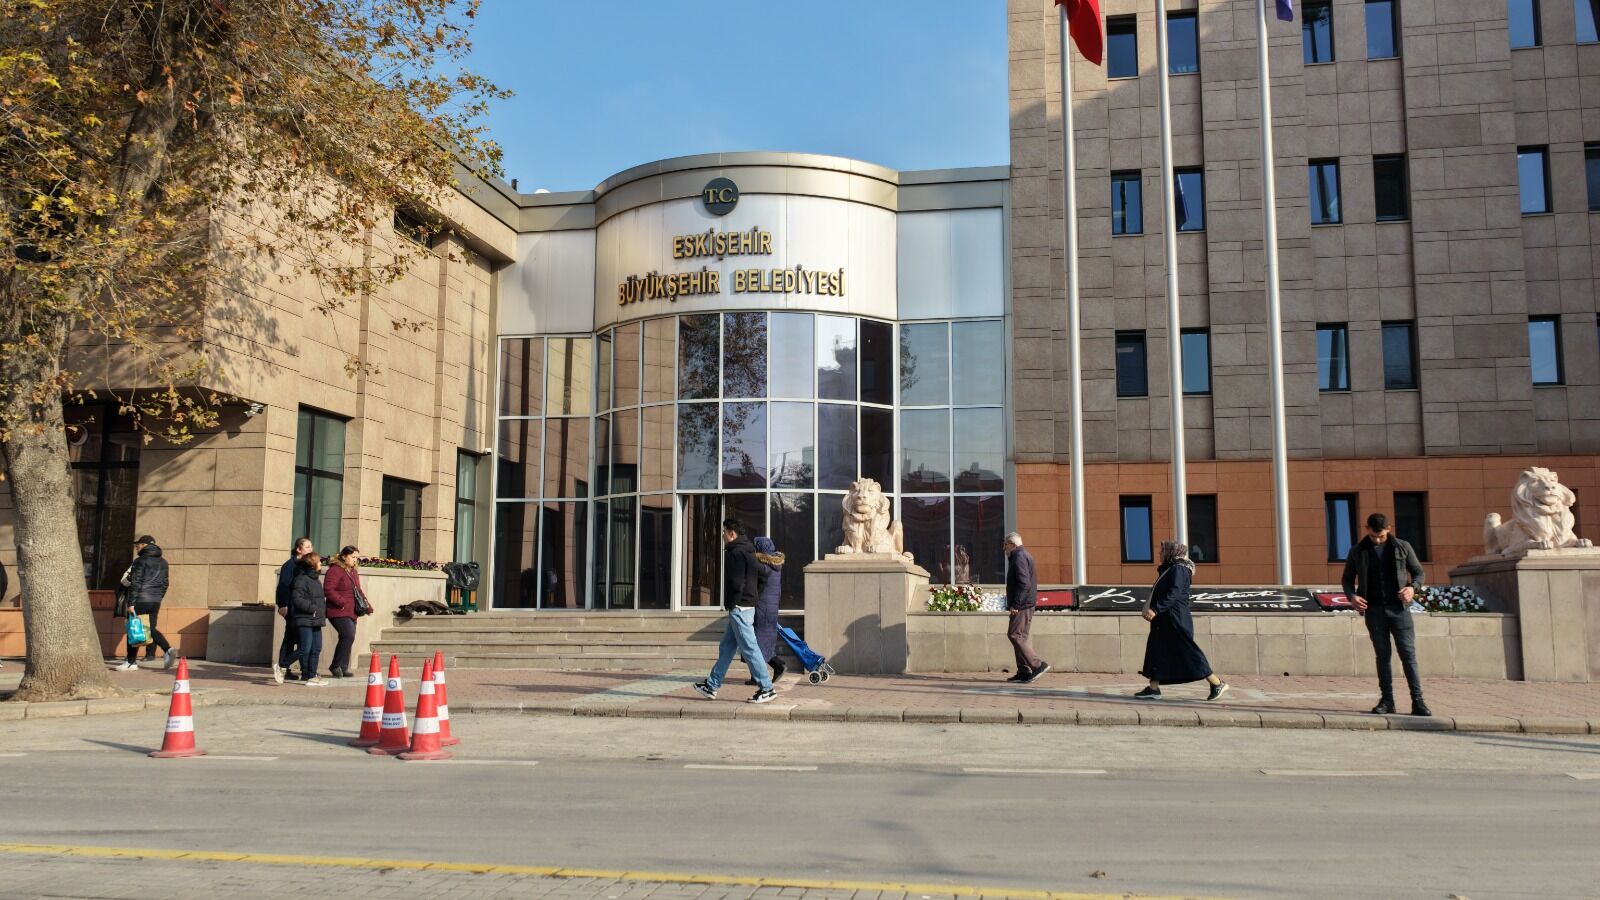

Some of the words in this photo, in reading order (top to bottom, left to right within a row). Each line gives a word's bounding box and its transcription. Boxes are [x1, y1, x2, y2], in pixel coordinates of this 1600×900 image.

[704, 187, 737, 205] T.C.
[672, 226, 773, 262] ESKİŞEHİR
[618, 265, 720, 306] BÜYÜKŞEHİR
[734, 264, 846, 297] BELEDİYESİ
